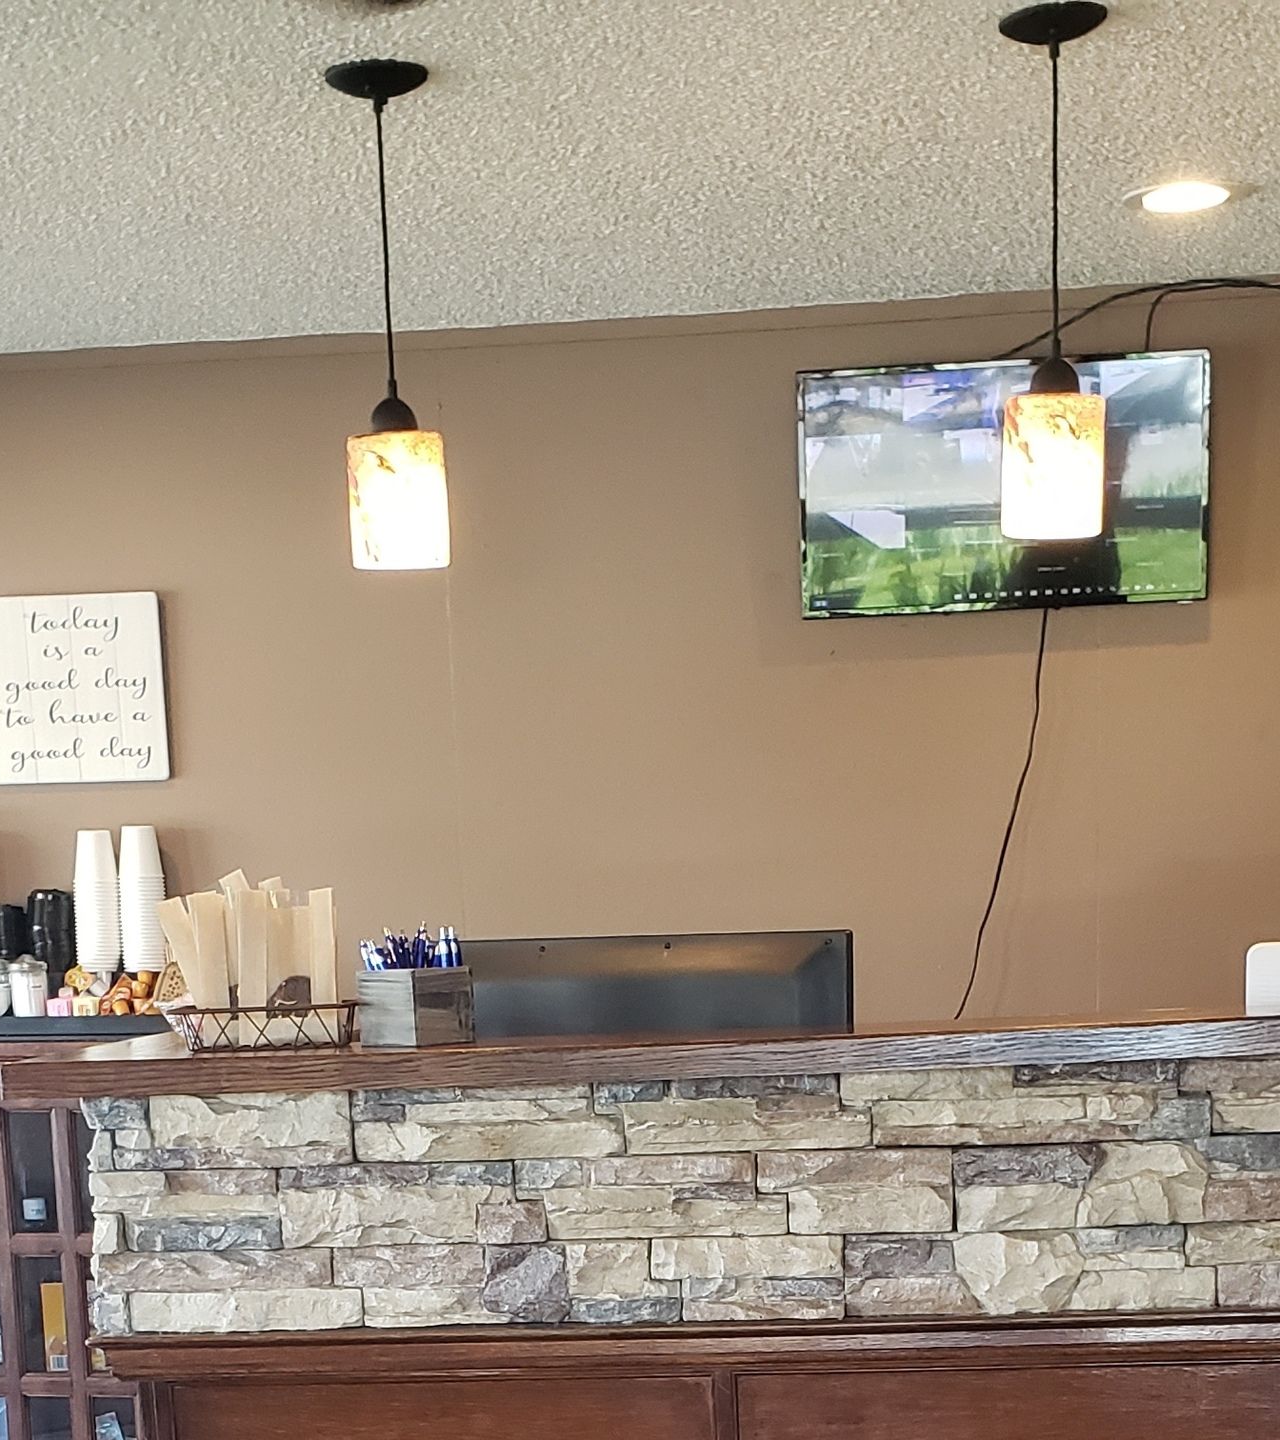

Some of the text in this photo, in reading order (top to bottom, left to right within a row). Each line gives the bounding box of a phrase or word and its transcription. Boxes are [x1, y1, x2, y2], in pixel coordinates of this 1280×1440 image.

[23, 606, 119, 642] today
[43, 644, 103, 661] is a
[5, 667, 147, 704] good day
[0, 698, 152, 728] to have a
[10, 736, 152, 773] good day
